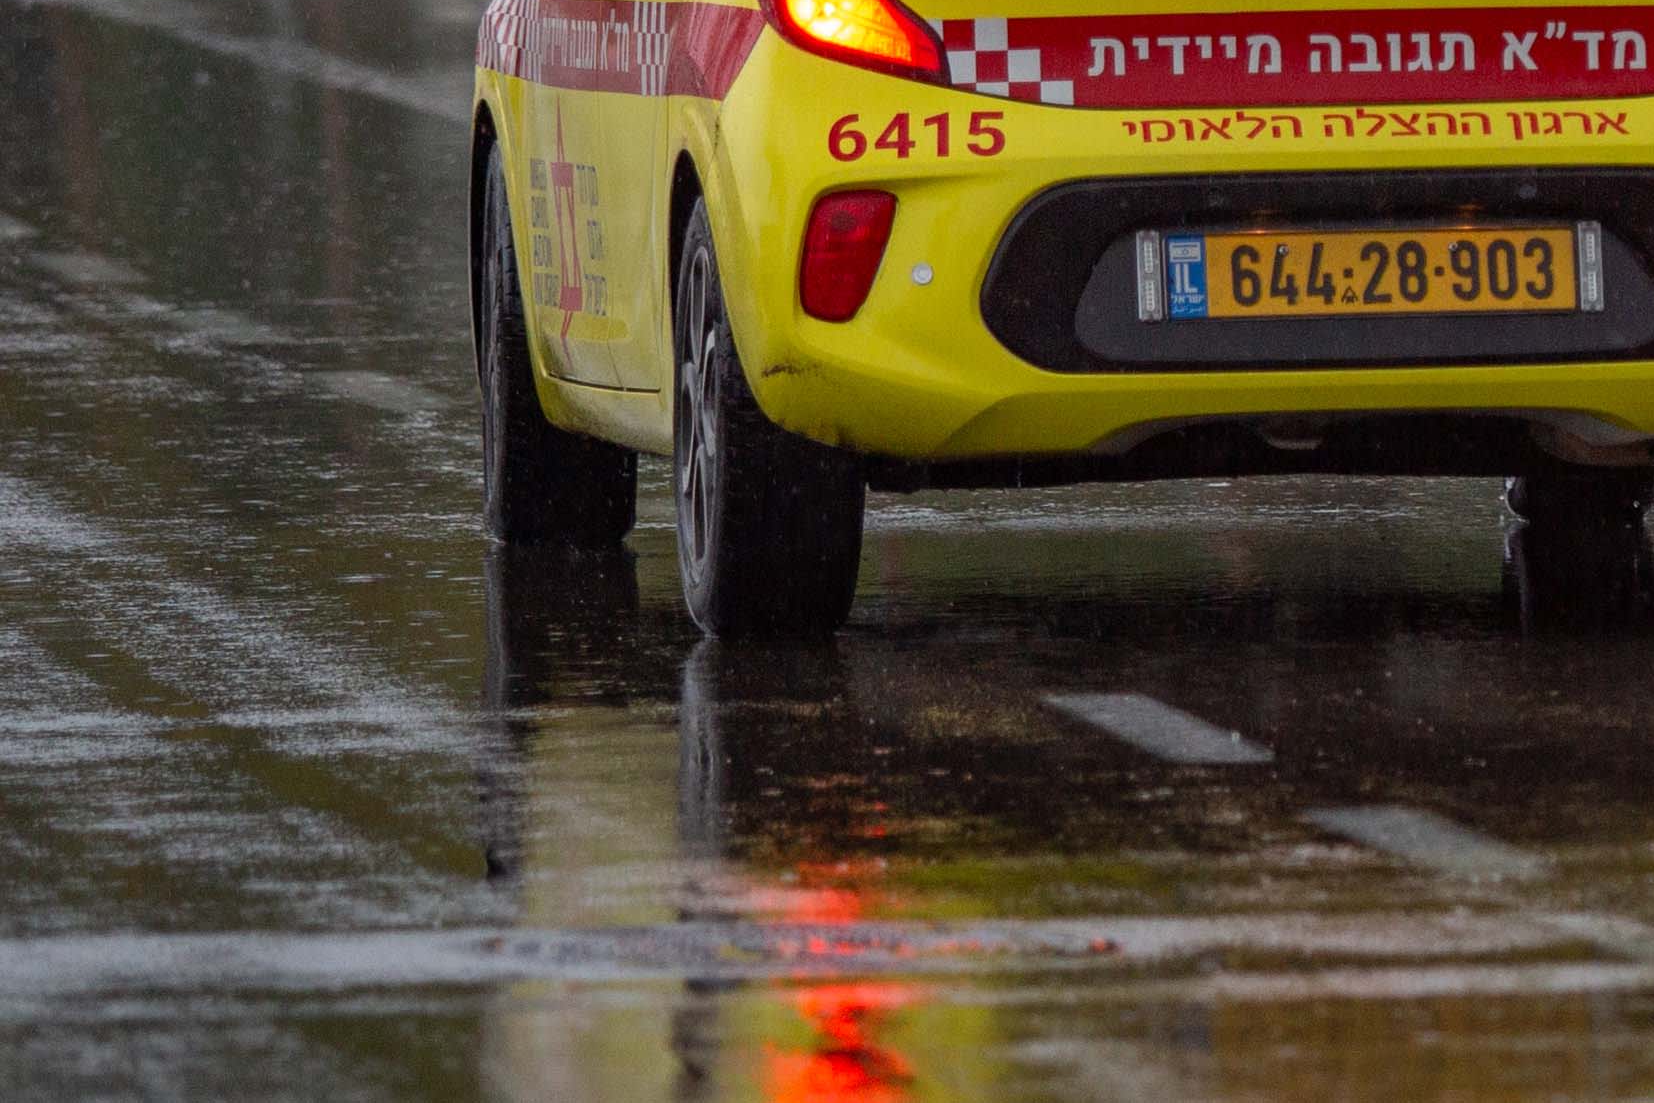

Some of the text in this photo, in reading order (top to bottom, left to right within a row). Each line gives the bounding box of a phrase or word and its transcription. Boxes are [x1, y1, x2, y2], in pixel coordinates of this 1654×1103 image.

[1087, 30, 1282, 79] מיידית
[1309, 28, 1476, 74] תגובה
[827, 111, 1007, 162] 6415
[1121, 108, 1630, 143] ארגון ההצלה הלאומי
[1175, 263, 1199, 294] IL
